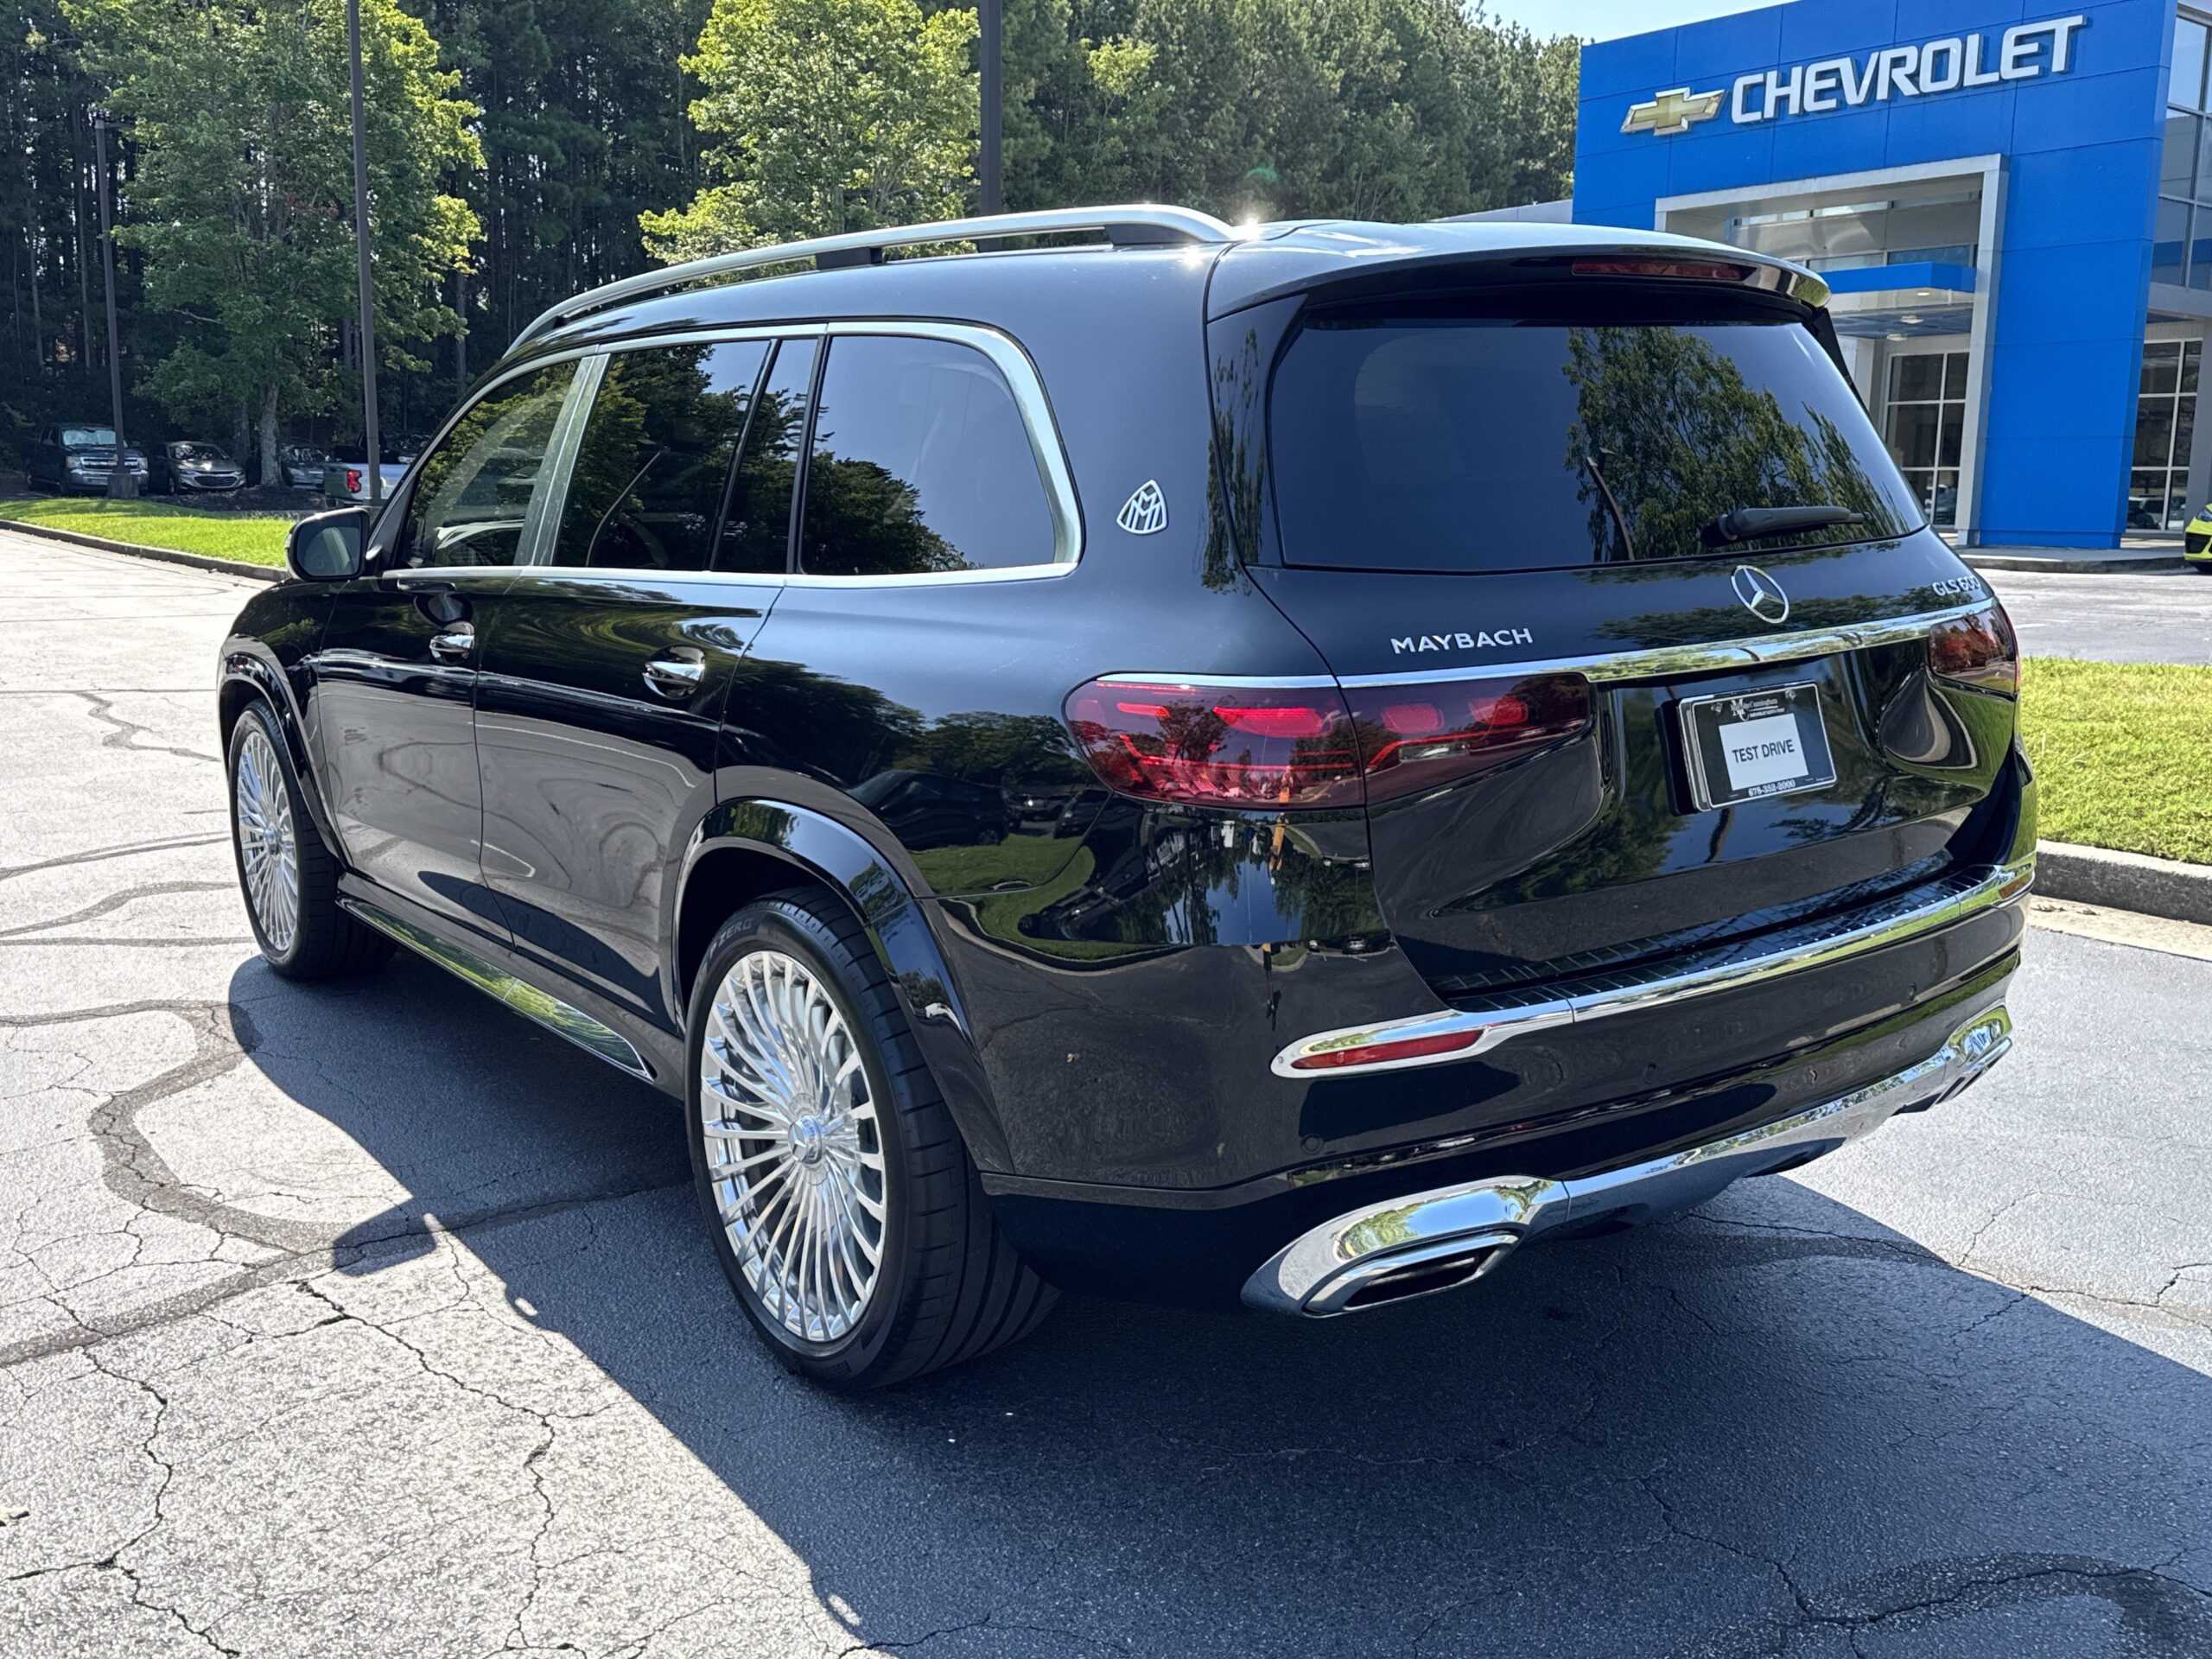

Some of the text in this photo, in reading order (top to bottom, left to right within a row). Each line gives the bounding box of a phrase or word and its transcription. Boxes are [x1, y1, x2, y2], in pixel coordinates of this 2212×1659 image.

[1731, 15, 2084, 123] CHEVROLET
[1390, 628, 1533, 654] MAYBACH
[1732, 740, 1795, 763] TEST DRIVE
[1748, 779, 1796, 797] 678-352-2000
[718, 918, 753, 947] ZERO
